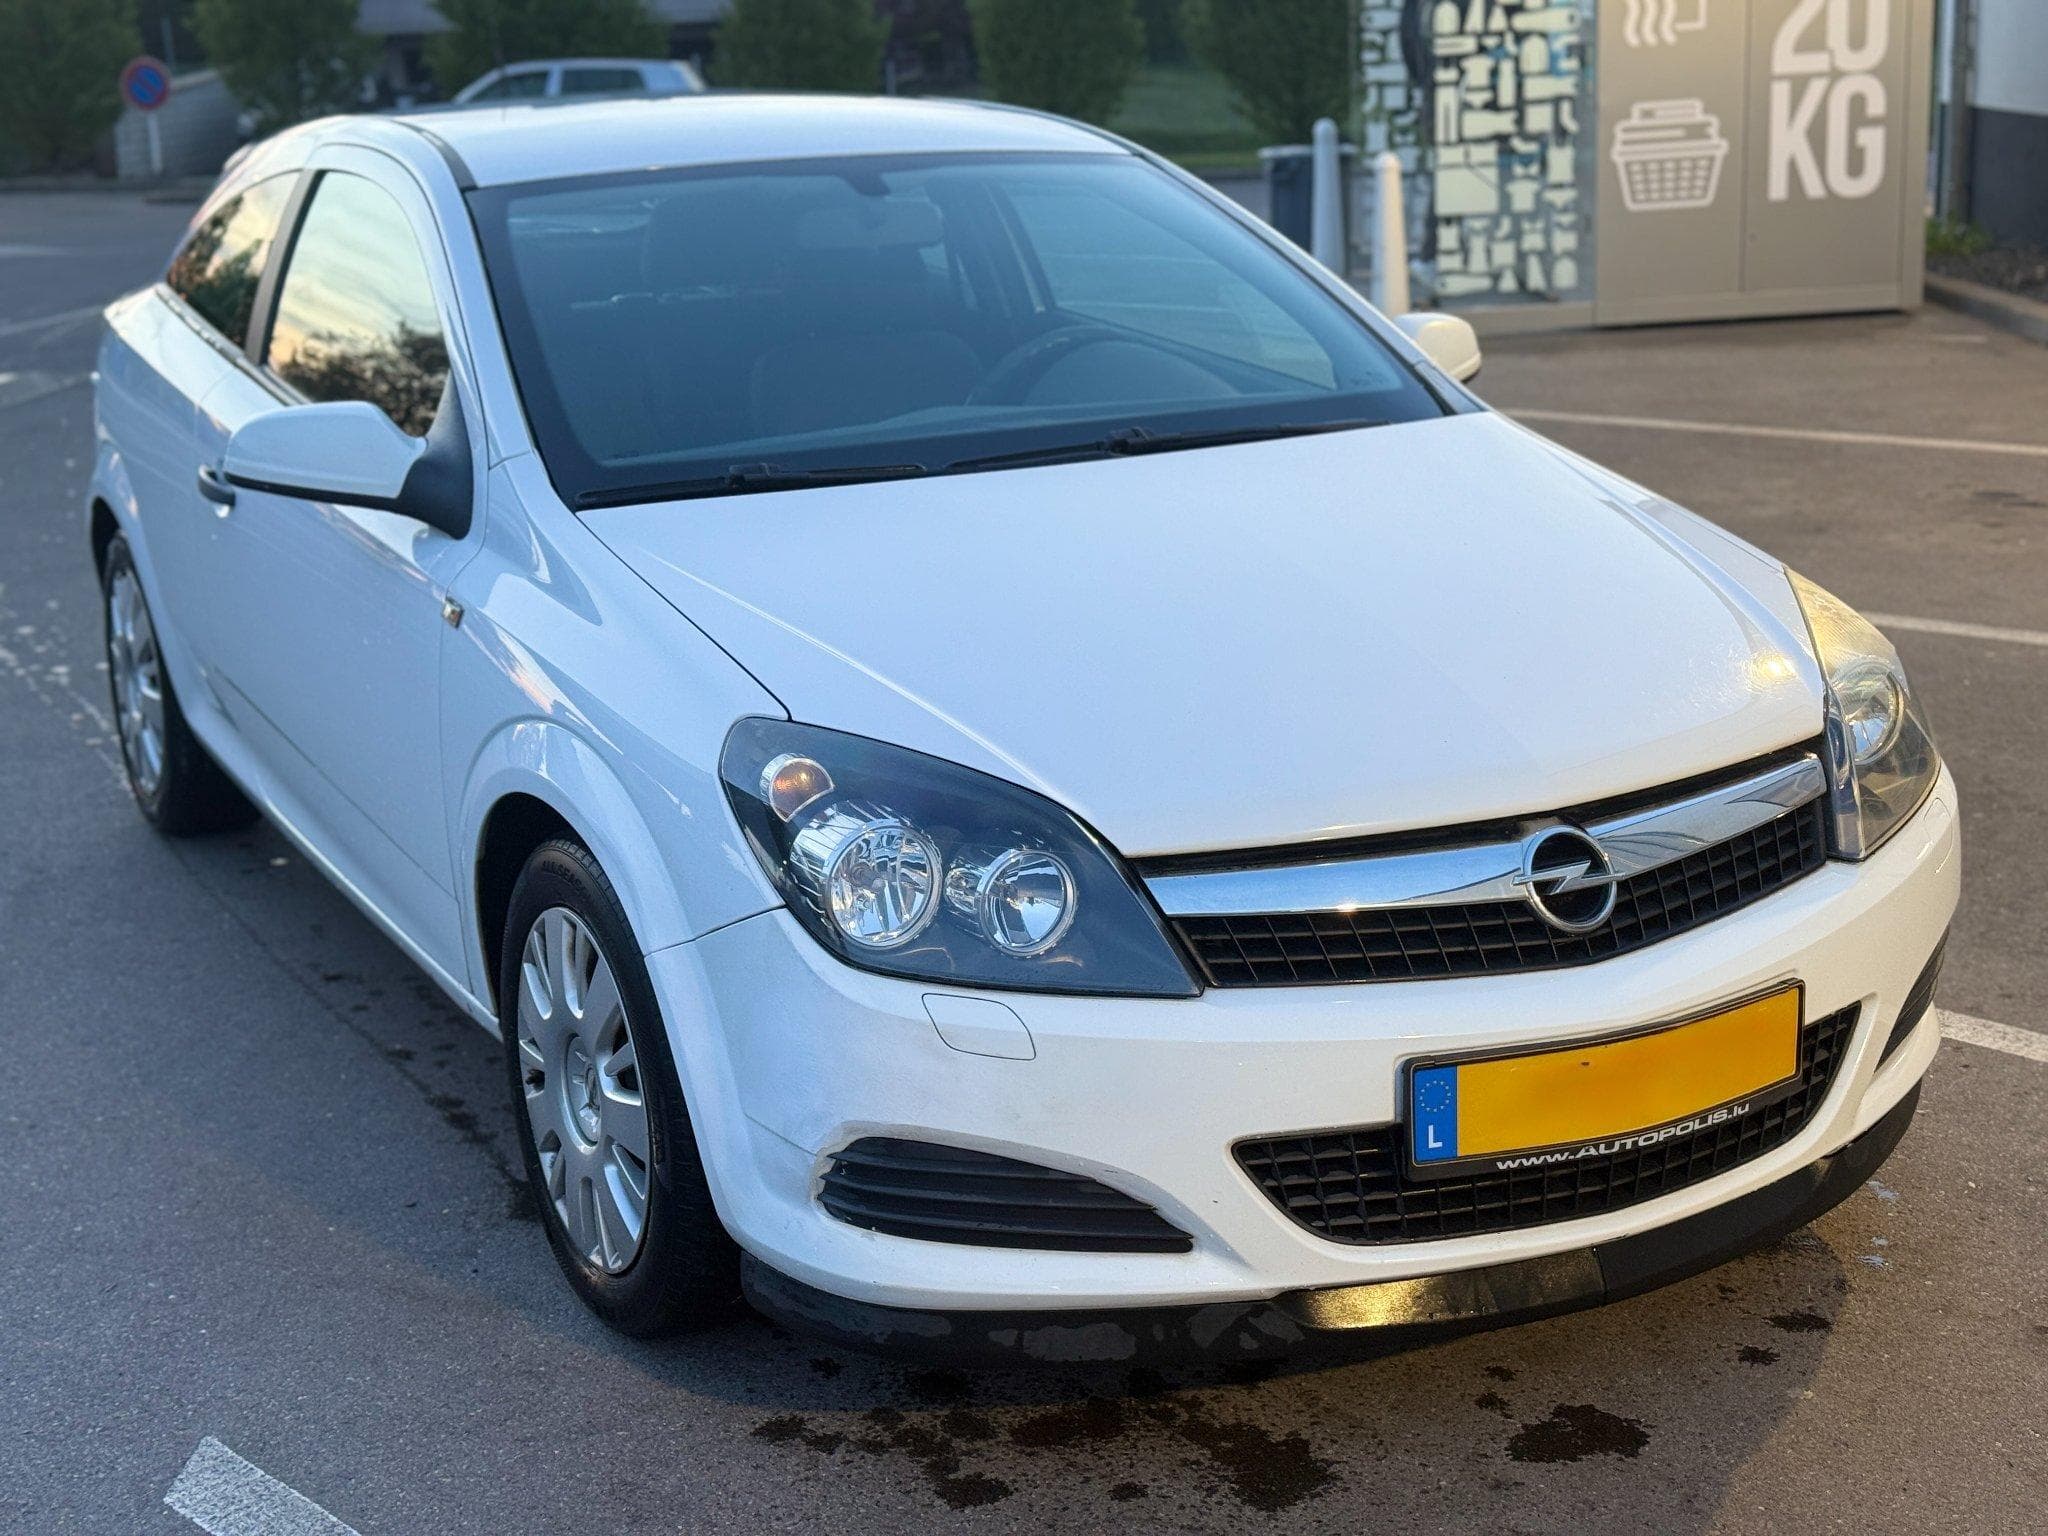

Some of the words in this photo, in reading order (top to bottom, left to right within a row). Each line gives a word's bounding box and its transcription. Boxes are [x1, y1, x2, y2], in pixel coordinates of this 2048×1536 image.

[1767, 73, 1888, 201] KG
[1428, 1124, 1443, 1149] L
[1496, 1102, 1750, 1170] www.AUTOPOLIS.lu
